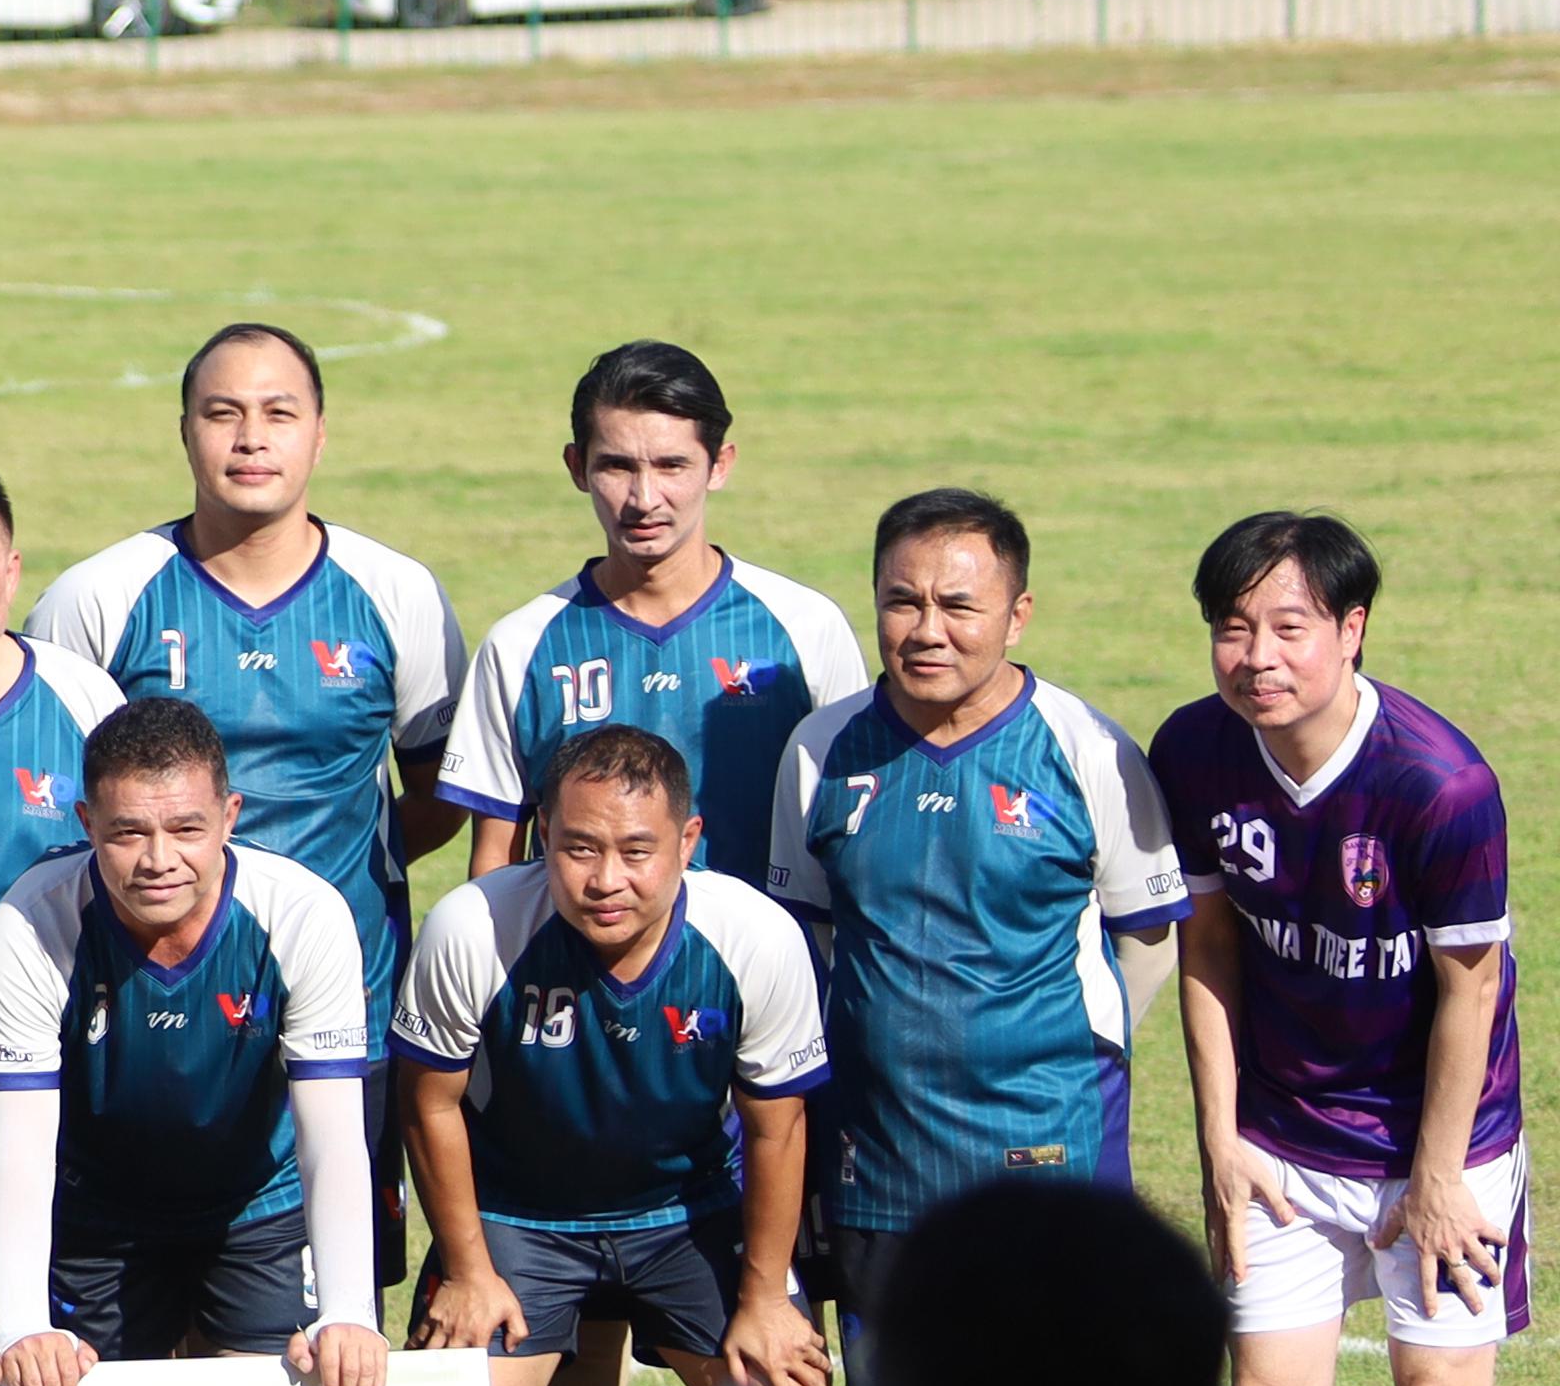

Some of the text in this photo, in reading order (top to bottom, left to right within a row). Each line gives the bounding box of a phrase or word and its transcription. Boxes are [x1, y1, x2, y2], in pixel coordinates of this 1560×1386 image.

[160, 629, 187, 691] 1
[551, 657, 613, 725] 10
[846, 773, 879, 835] 7
[1210, 812, 1277, 883] 29
[1311, 923, 1368, 980] TREE
